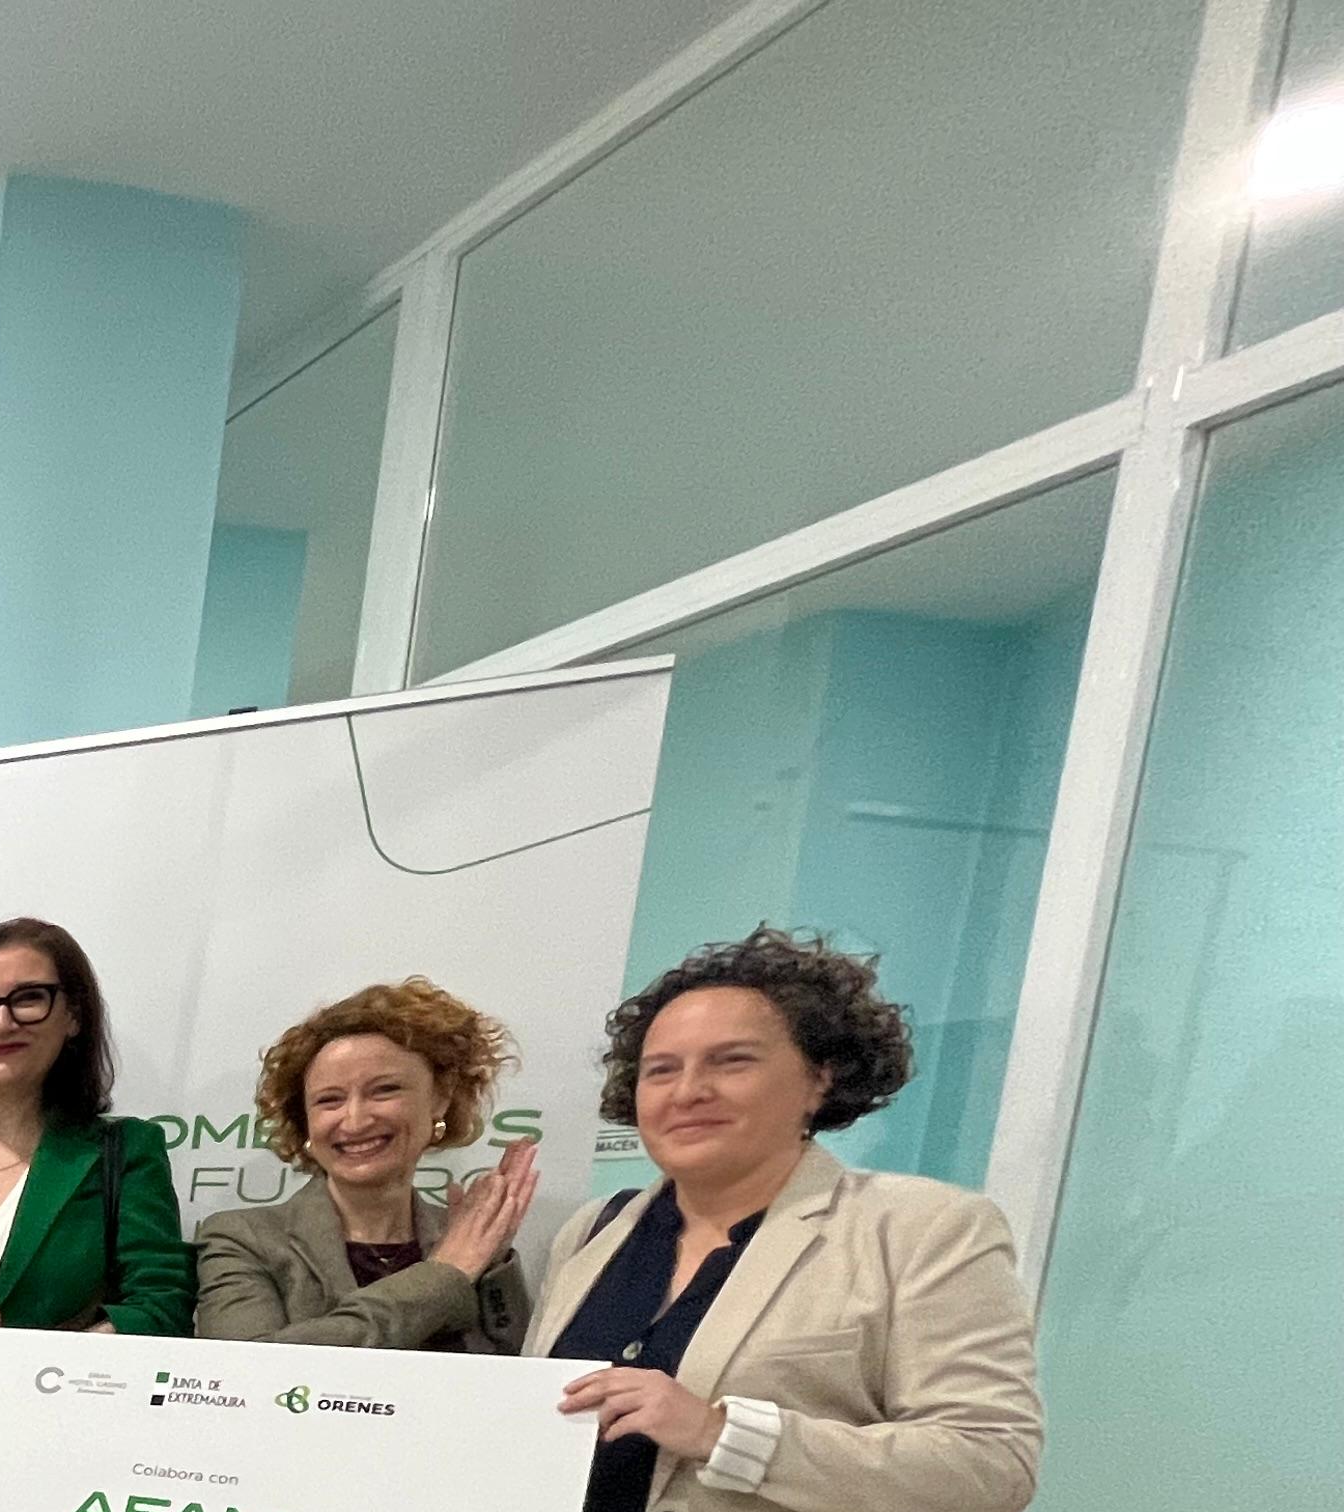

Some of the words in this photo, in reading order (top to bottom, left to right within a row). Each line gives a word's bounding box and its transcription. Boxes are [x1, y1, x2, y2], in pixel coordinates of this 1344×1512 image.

[171, 1377, 203, 1391] JUNTA
[208, 1379, 222, 1392] DE
[167, 1391, 248, 1409] EXTREMADURA
[317, 1399, 396, 1417] ORENES
[131, 1462, 205, 1483] Colabora
[208, 1471, 240, 1487] con
